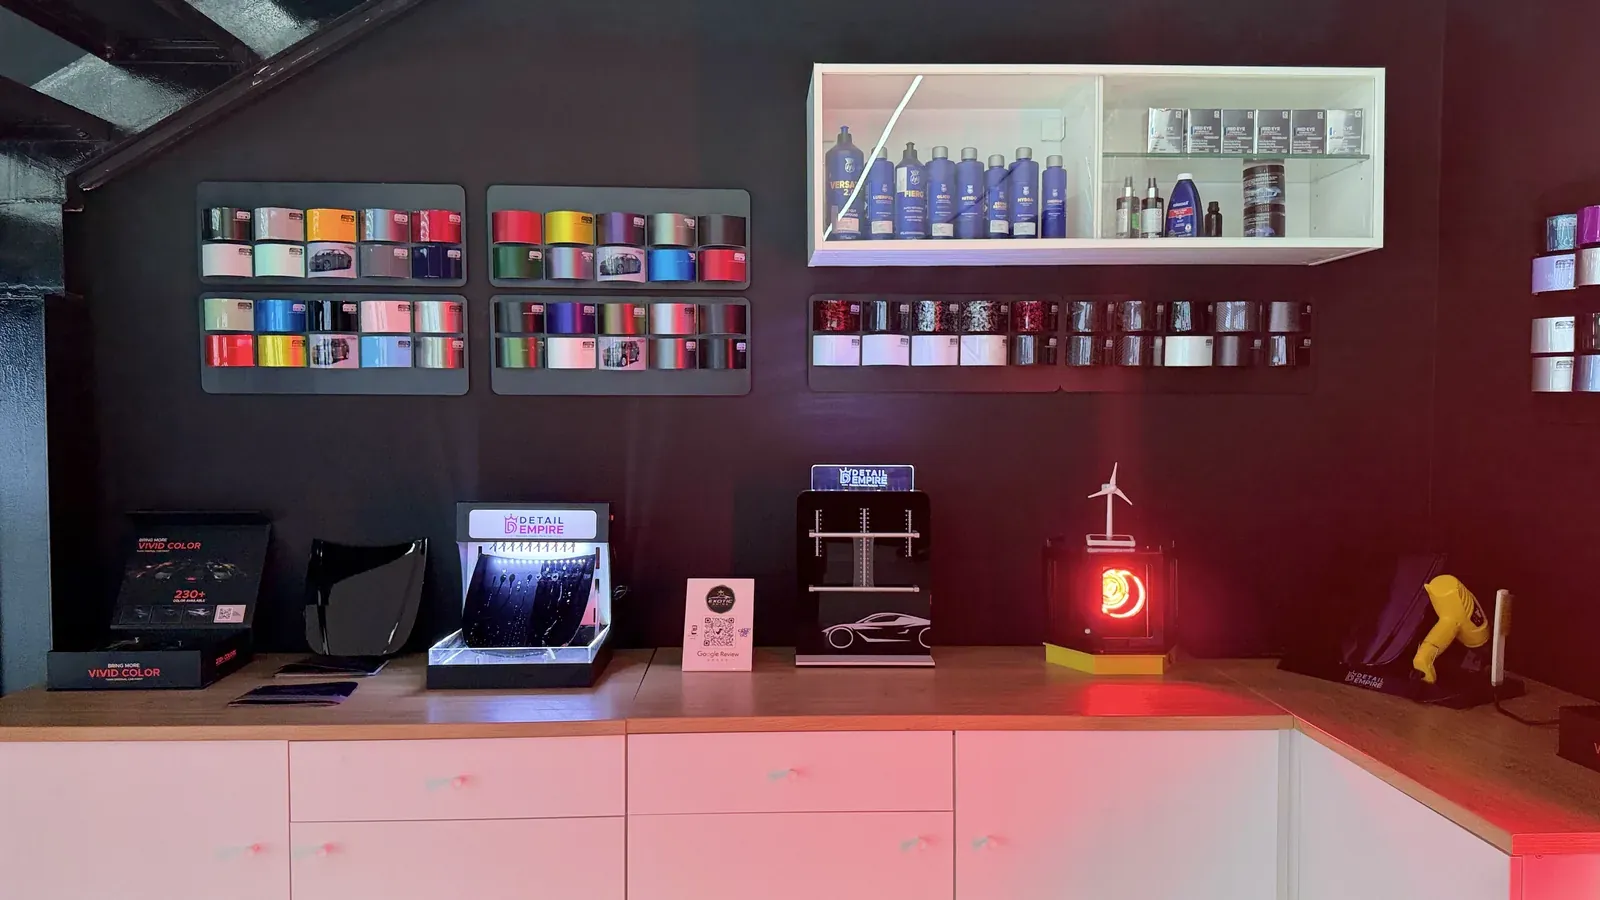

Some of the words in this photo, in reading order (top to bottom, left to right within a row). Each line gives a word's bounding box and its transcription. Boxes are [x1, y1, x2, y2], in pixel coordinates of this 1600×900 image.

[831, 180, 857, 189] VERSA
[852, 476, 887, 484] EMPIRE
[519, 516, 564, 524] DETAIL
[519, 525, 564, 534] EMPIRE
[174, 589, 205, 599] 230+
[696, 650, 719, 658] Google
[88, 668, 119, 678] VIVID
[121, 668, 160, 677] COLOR
[1357, 673, 1384, 683] DETAIL
[1354, 678, 1383, 688] EMPIRE
